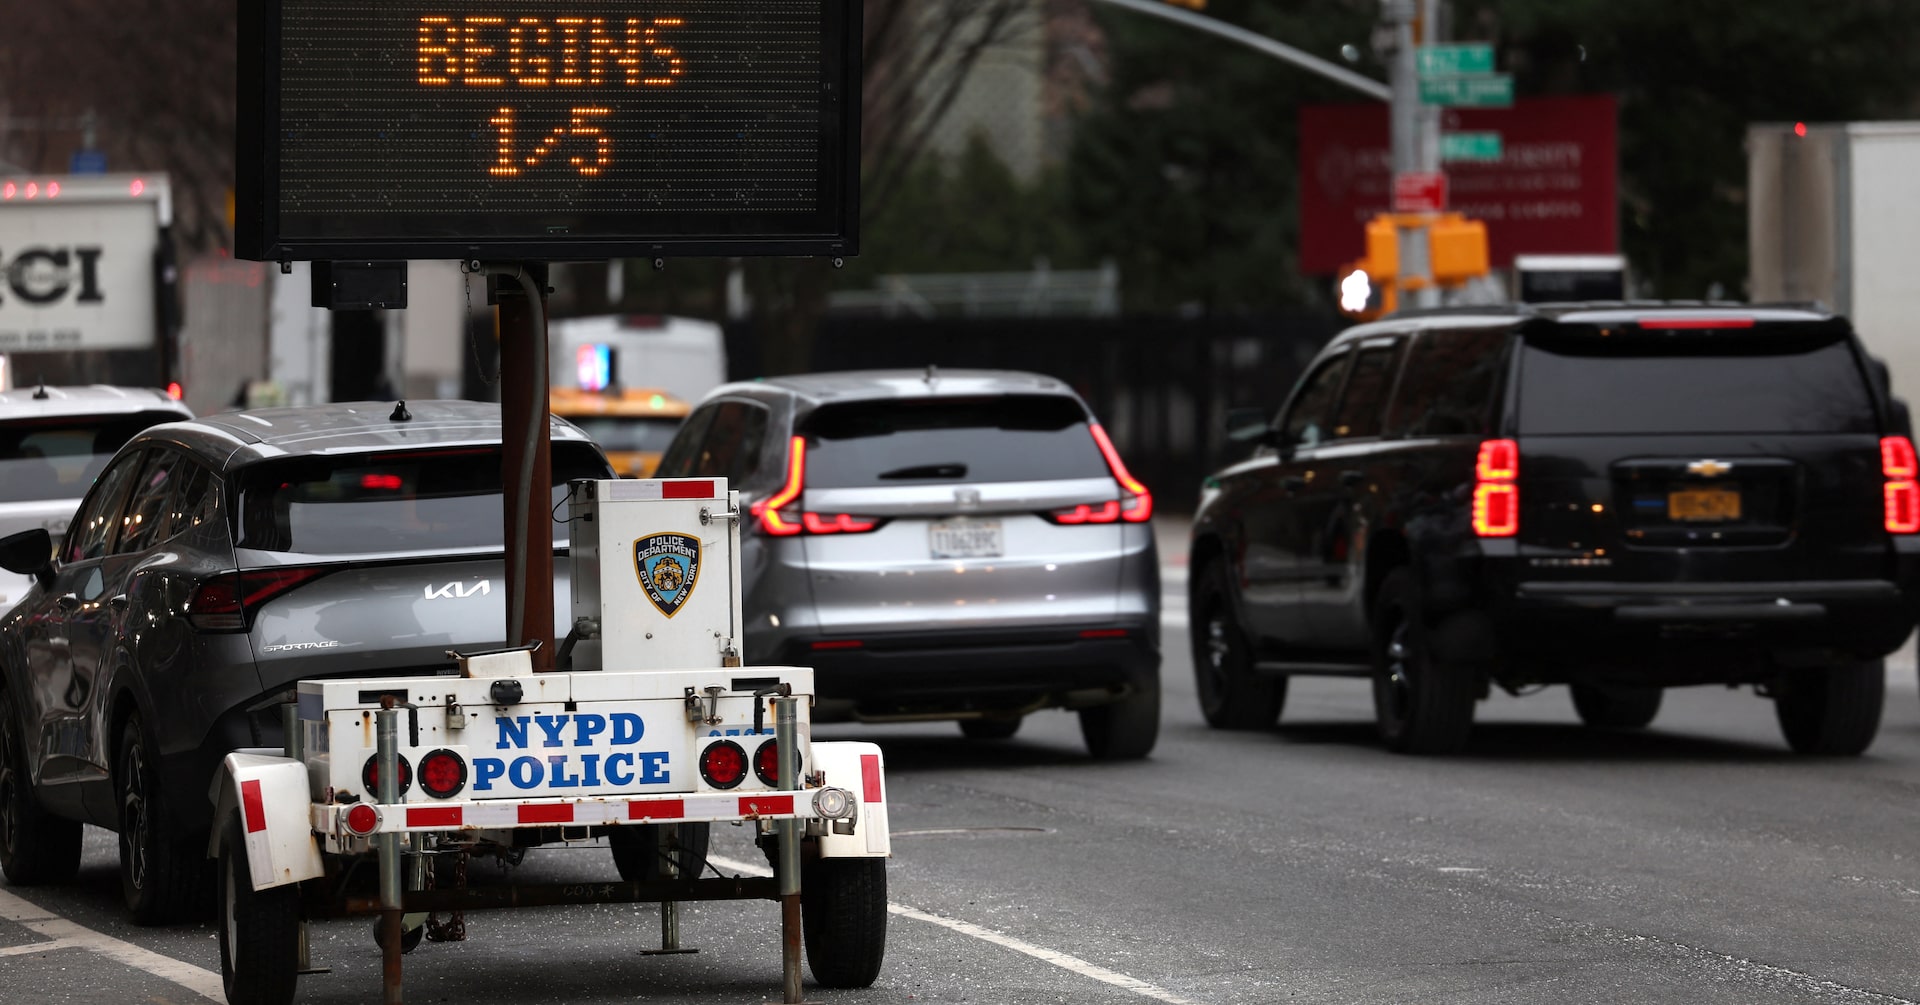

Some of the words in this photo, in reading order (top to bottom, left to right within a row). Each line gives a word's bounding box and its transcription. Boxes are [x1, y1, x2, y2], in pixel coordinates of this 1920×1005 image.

[418, 16, 686, 85] BEGINS
[489, 106, 612, 175] 1/5
[0, 246, 105, 305] CI
[637, 544, 697, 562] DEPARTMENT
[649, 535, 685, 547] POLICE
[424, 579, 491, 600] KIA
[639, 570, 653, 590] CITY
[650, 592, 662, 603] OF
[673, 588, 688, 606] NEW
[685, 563, 697, 586] YORK
[263, 640, 339, 653] SPORTAGE
[495, 712, 645, 750] NYPD
[472, 751, 670, 791] POLICE
